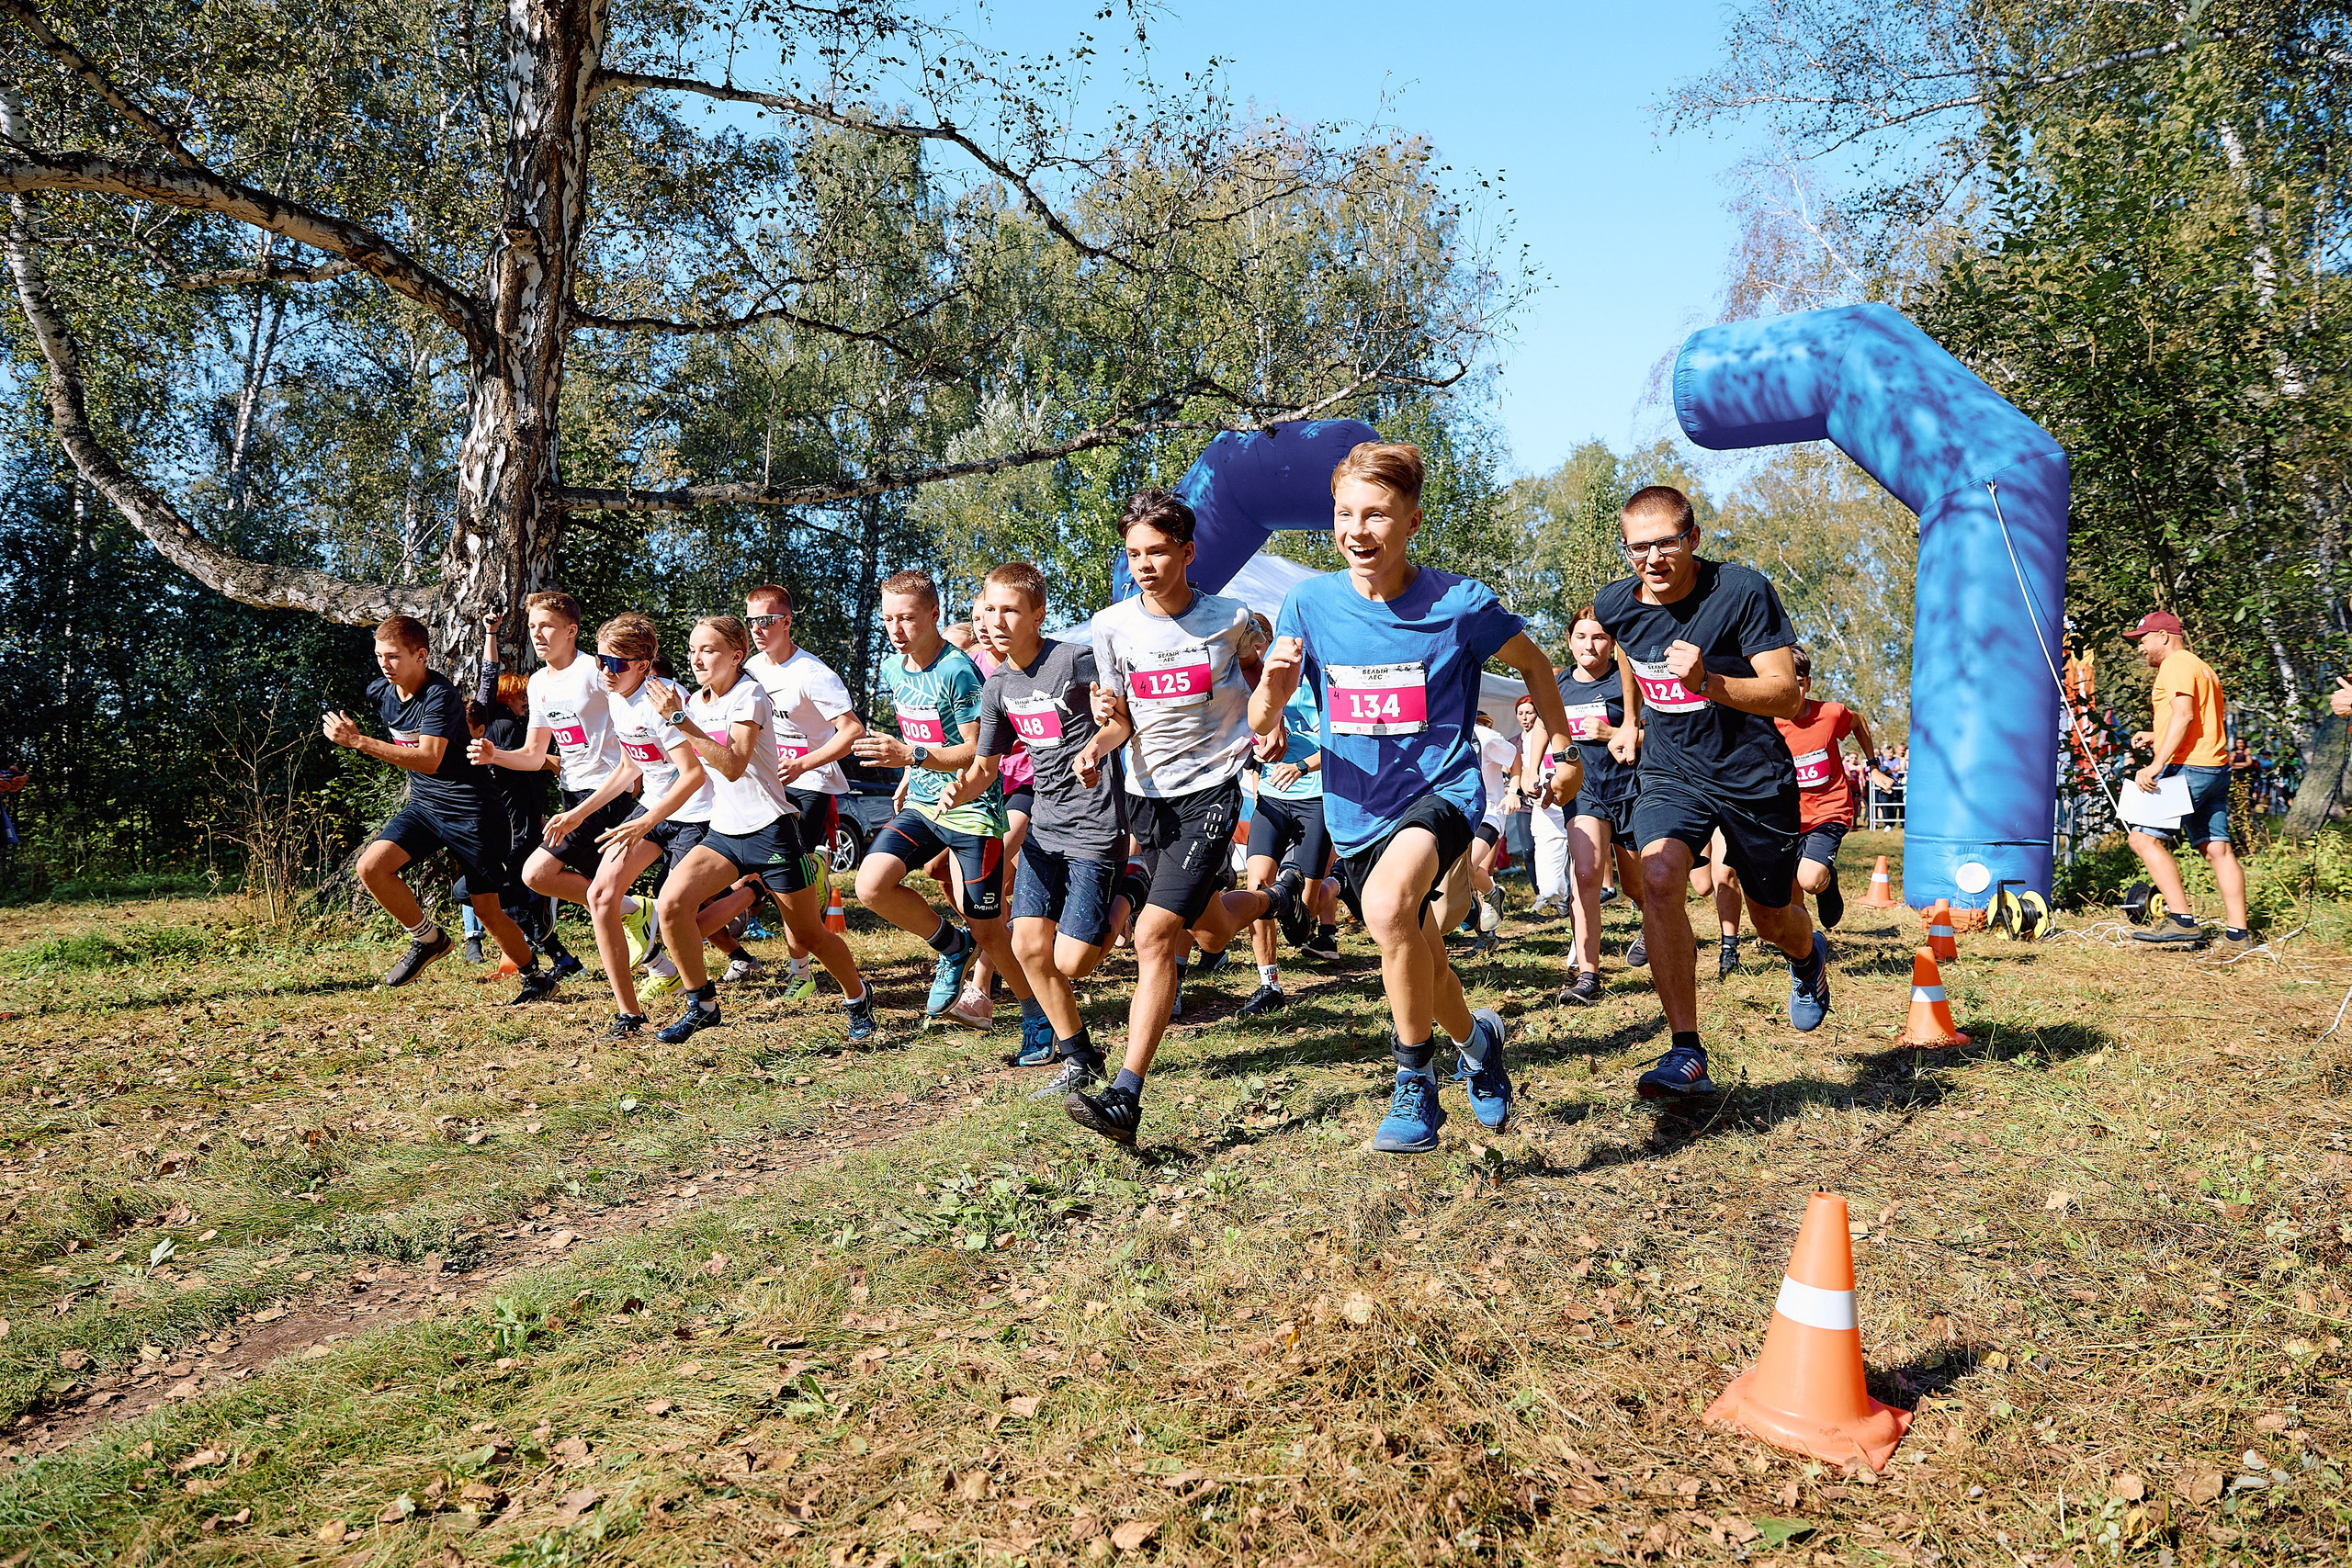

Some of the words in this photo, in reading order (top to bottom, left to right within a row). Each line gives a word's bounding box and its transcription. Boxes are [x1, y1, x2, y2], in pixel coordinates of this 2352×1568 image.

[1158, 651, 1180, 660] БЕЛЫЙ
[1362, 667, 1389, 675] БЕЛЫЙ
[1140, 681, 1147, 694] 4
[1148, 671, 1192, 695] 125
[1645, 682, 1686, 701] 124
[1350, 693, 1401, 719] 134
[901, 719, 932, 740] 008
[1014, 716, 1045, 736] 148
[1568, 720, 1585, 734] 14
[625, 744, 650, 761] 126
[1796, 766, 1819, 781] 16
[1264, 967, 1277, 976] JUS
